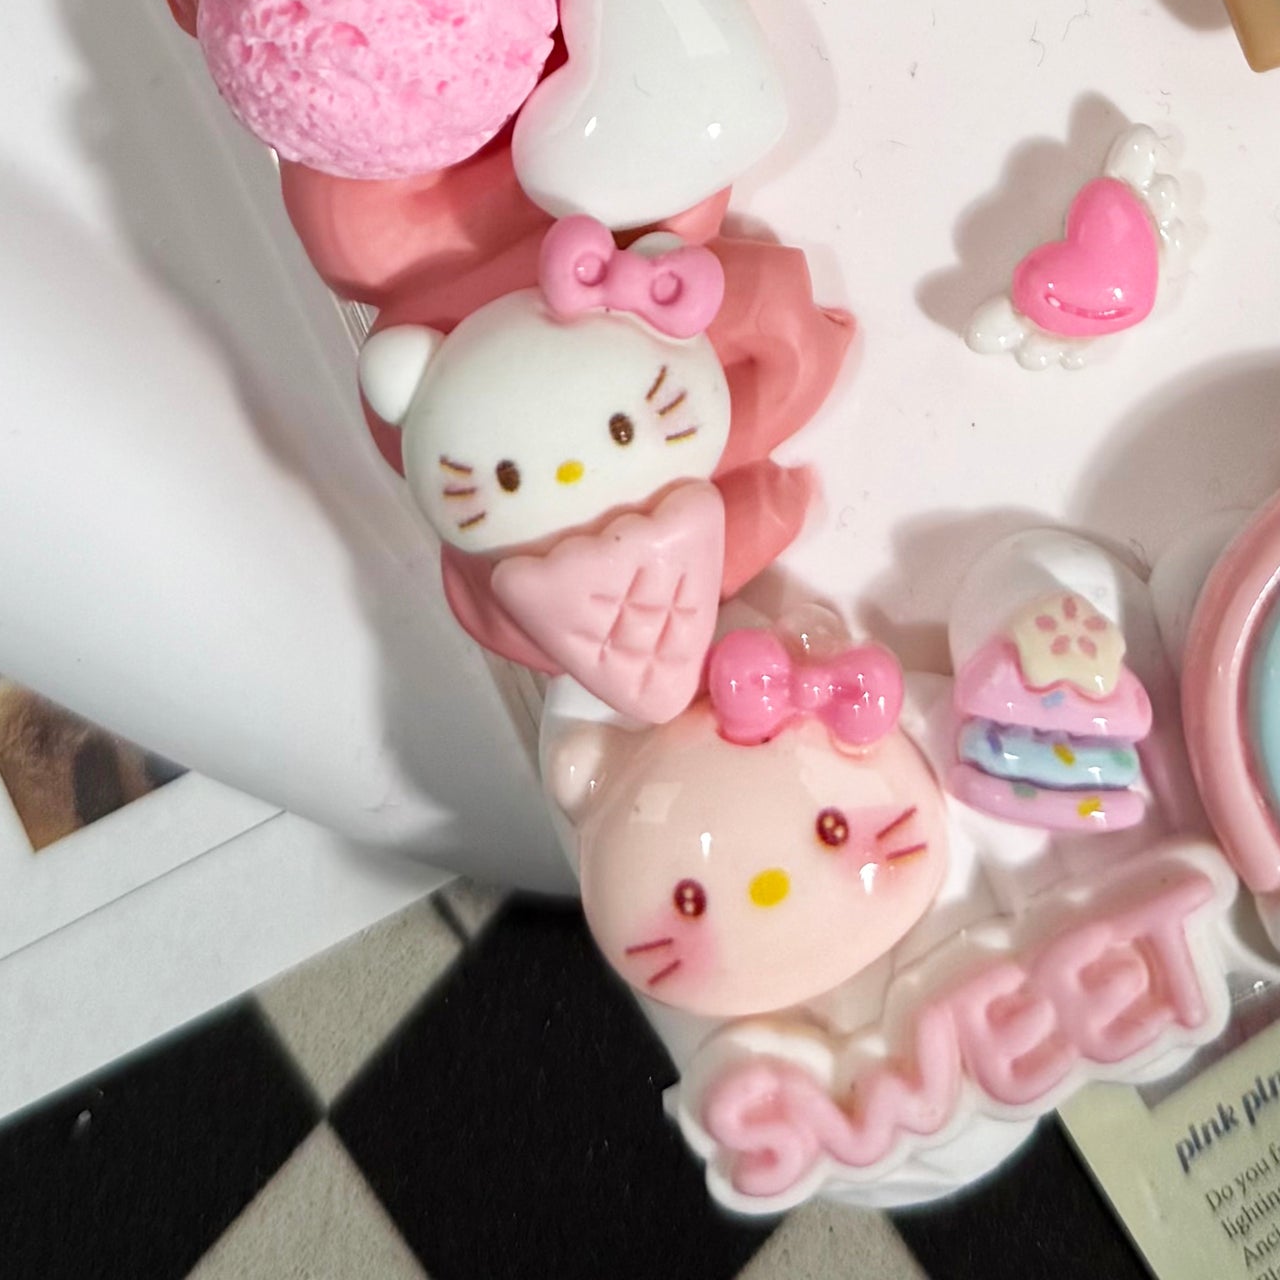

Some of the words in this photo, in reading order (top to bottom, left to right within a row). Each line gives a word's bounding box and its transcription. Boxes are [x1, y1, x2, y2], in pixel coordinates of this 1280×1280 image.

[702, 860, 1215, 1198] SWEET
[1203, 1183, 1235, 1211] Do
[1234, 1158, 1271, 1196] you
